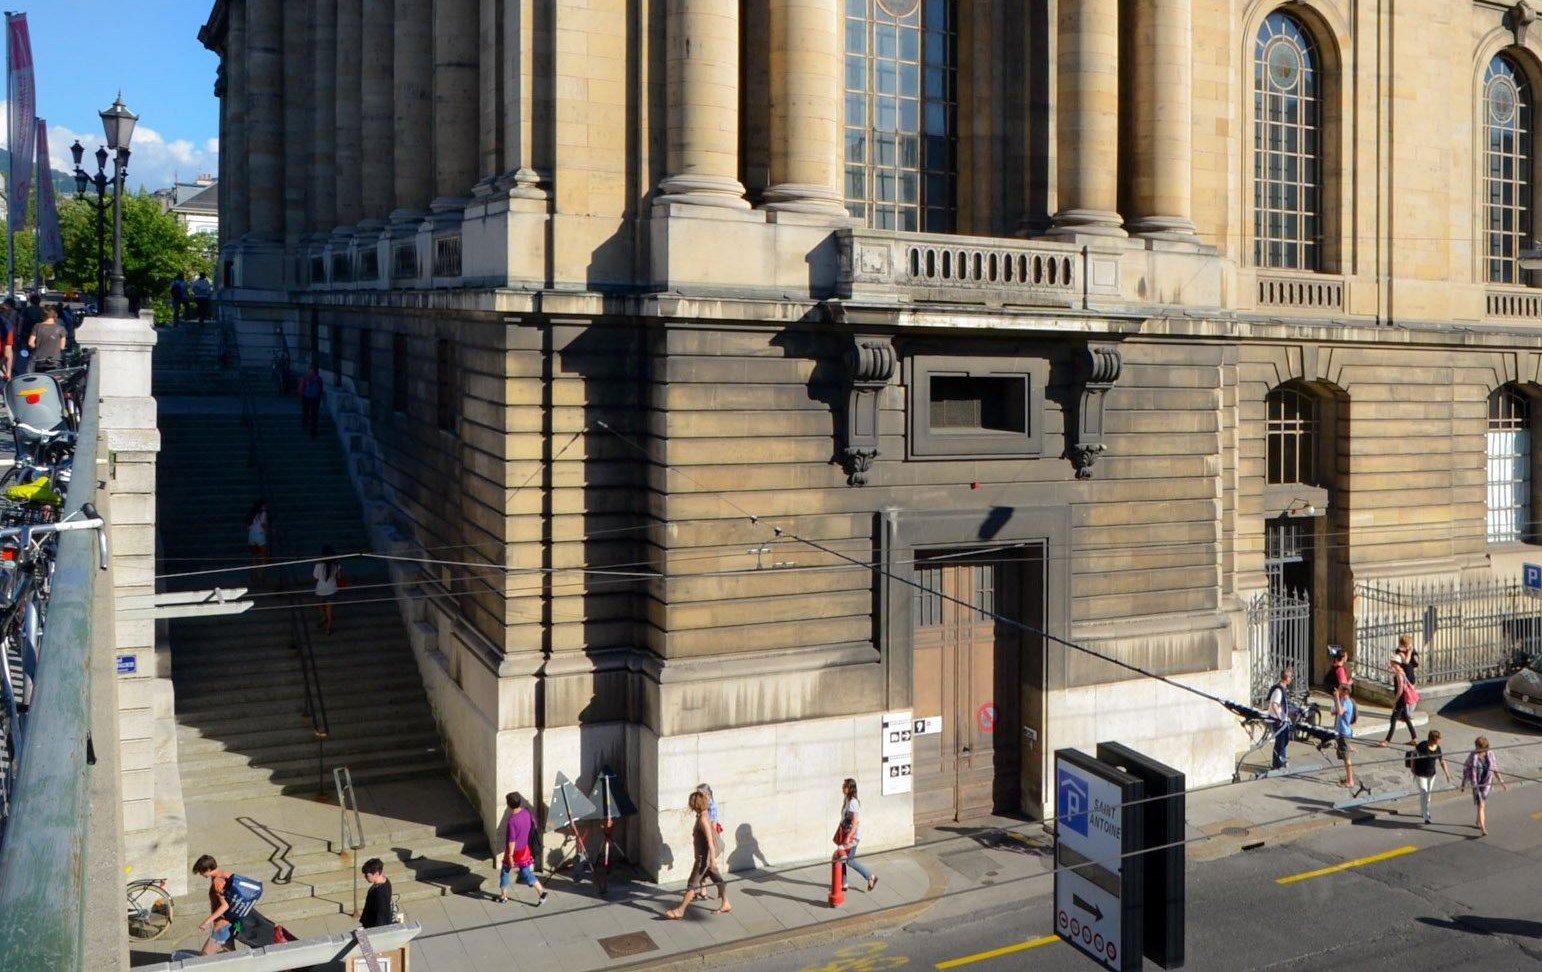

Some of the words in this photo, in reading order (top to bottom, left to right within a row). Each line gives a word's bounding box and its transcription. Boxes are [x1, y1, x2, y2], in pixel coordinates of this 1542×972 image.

[1528, 568, 1538, 585] P
[916, 721, 924, 732] 9
[1067, 789, 1080, 822] P
[1094, 798, 1117, 819] SAINT
[1089, 811, 1121, 840] ANTOINE
